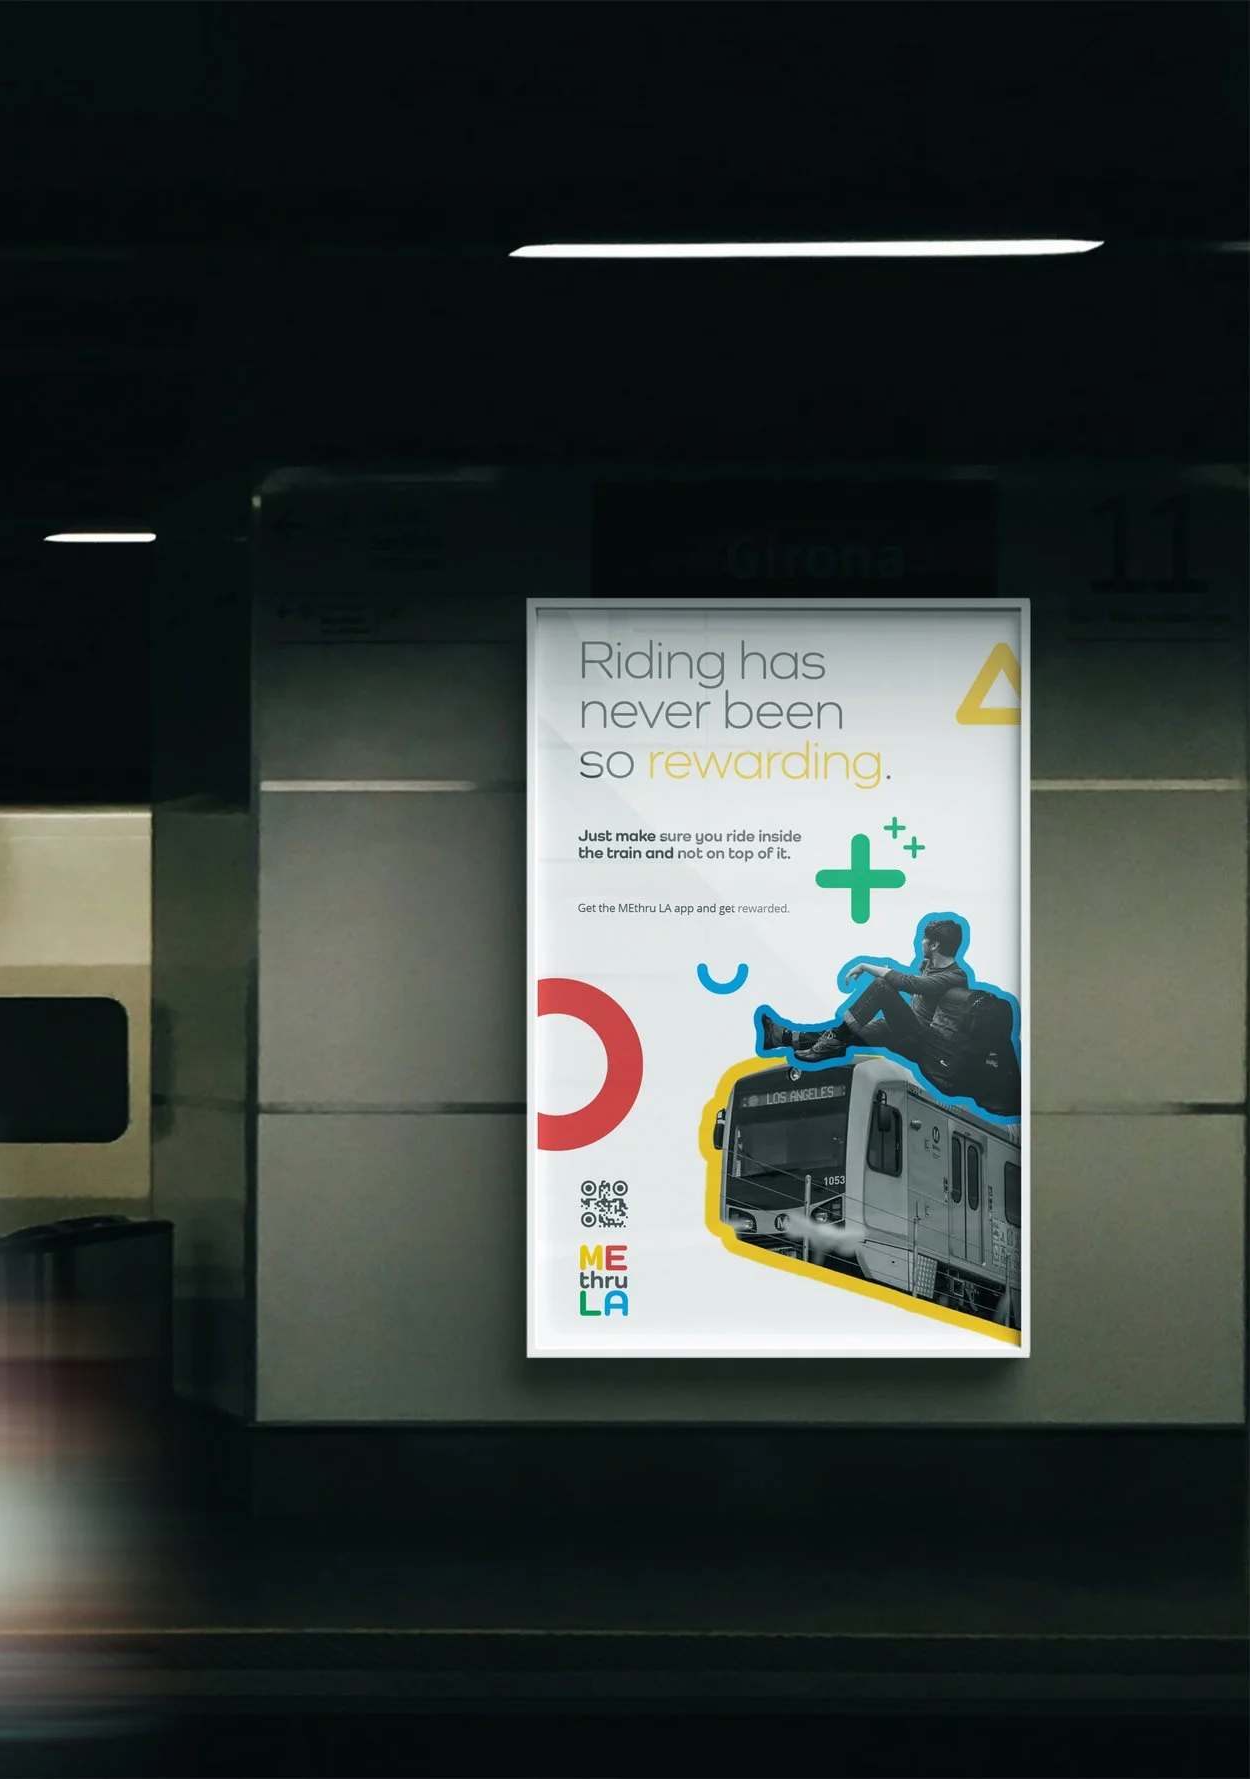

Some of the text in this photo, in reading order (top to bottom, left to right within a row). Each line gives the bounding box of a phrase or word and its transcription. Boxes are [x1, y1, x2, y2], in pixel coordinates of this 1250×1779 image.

[1091, 494, 1209, 593] 11
[727, 534, 906, 579] Girona
[580, 640, 826, 689] Riding has
[580, 690, 843, 729] never been
[579, 741, 891, 789] so rewarding.
[578, 829, 802, 845] Just make sure you ride inside
[578, 847, 791, 862] the train and not on top of it.
[578, 903, 790, 916] Get the MEthru LA app and get rewarded.
[766, 1086, 834, 1105] LOS ANGELES
[824, 1175, 846, 1186] 1053
[580, 1245, 628, 1270] ME
[580, 1270, 628, 1288] thru
[580, 1290, 628, 1316] LA
